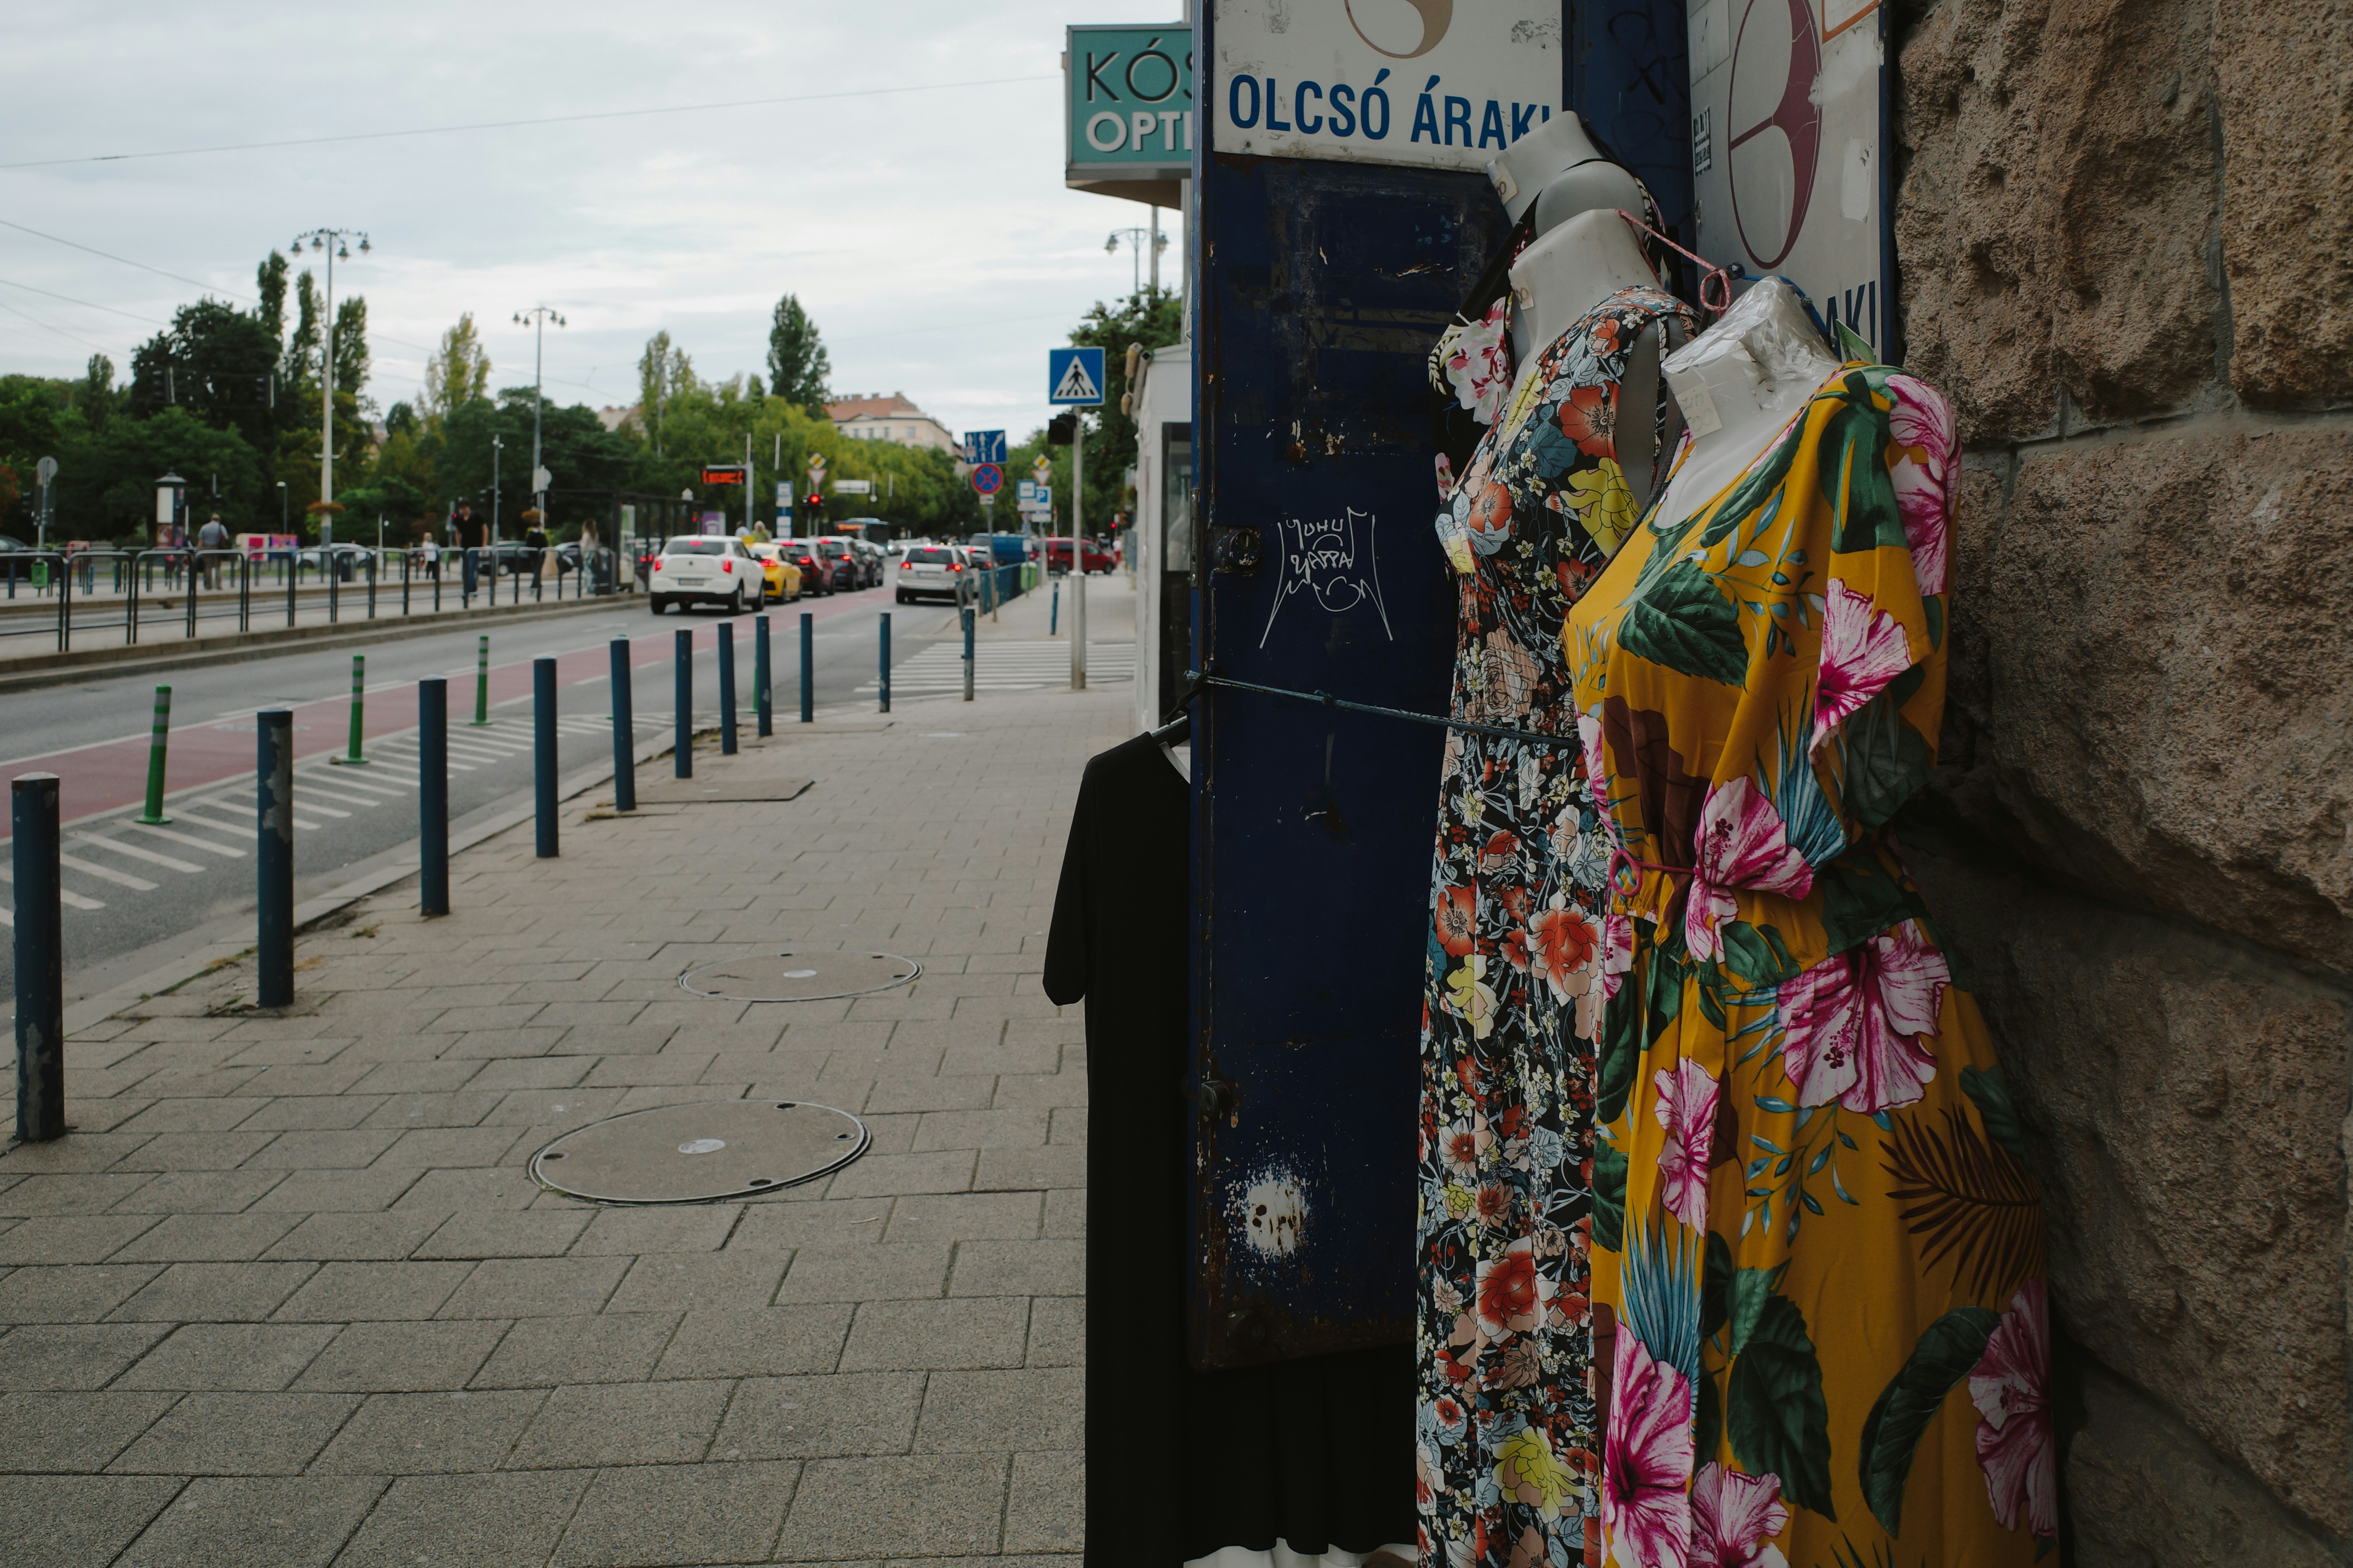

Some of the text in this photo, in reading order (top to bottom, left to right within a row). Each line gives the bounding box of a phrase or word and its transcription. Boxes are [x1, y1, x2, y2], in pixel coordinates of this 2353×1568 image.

[1229, 68, 1390, 140] OLCSÓ
[1086, 111, 1192, 152] OPTI
[1037, 490, 1046, 502] P
